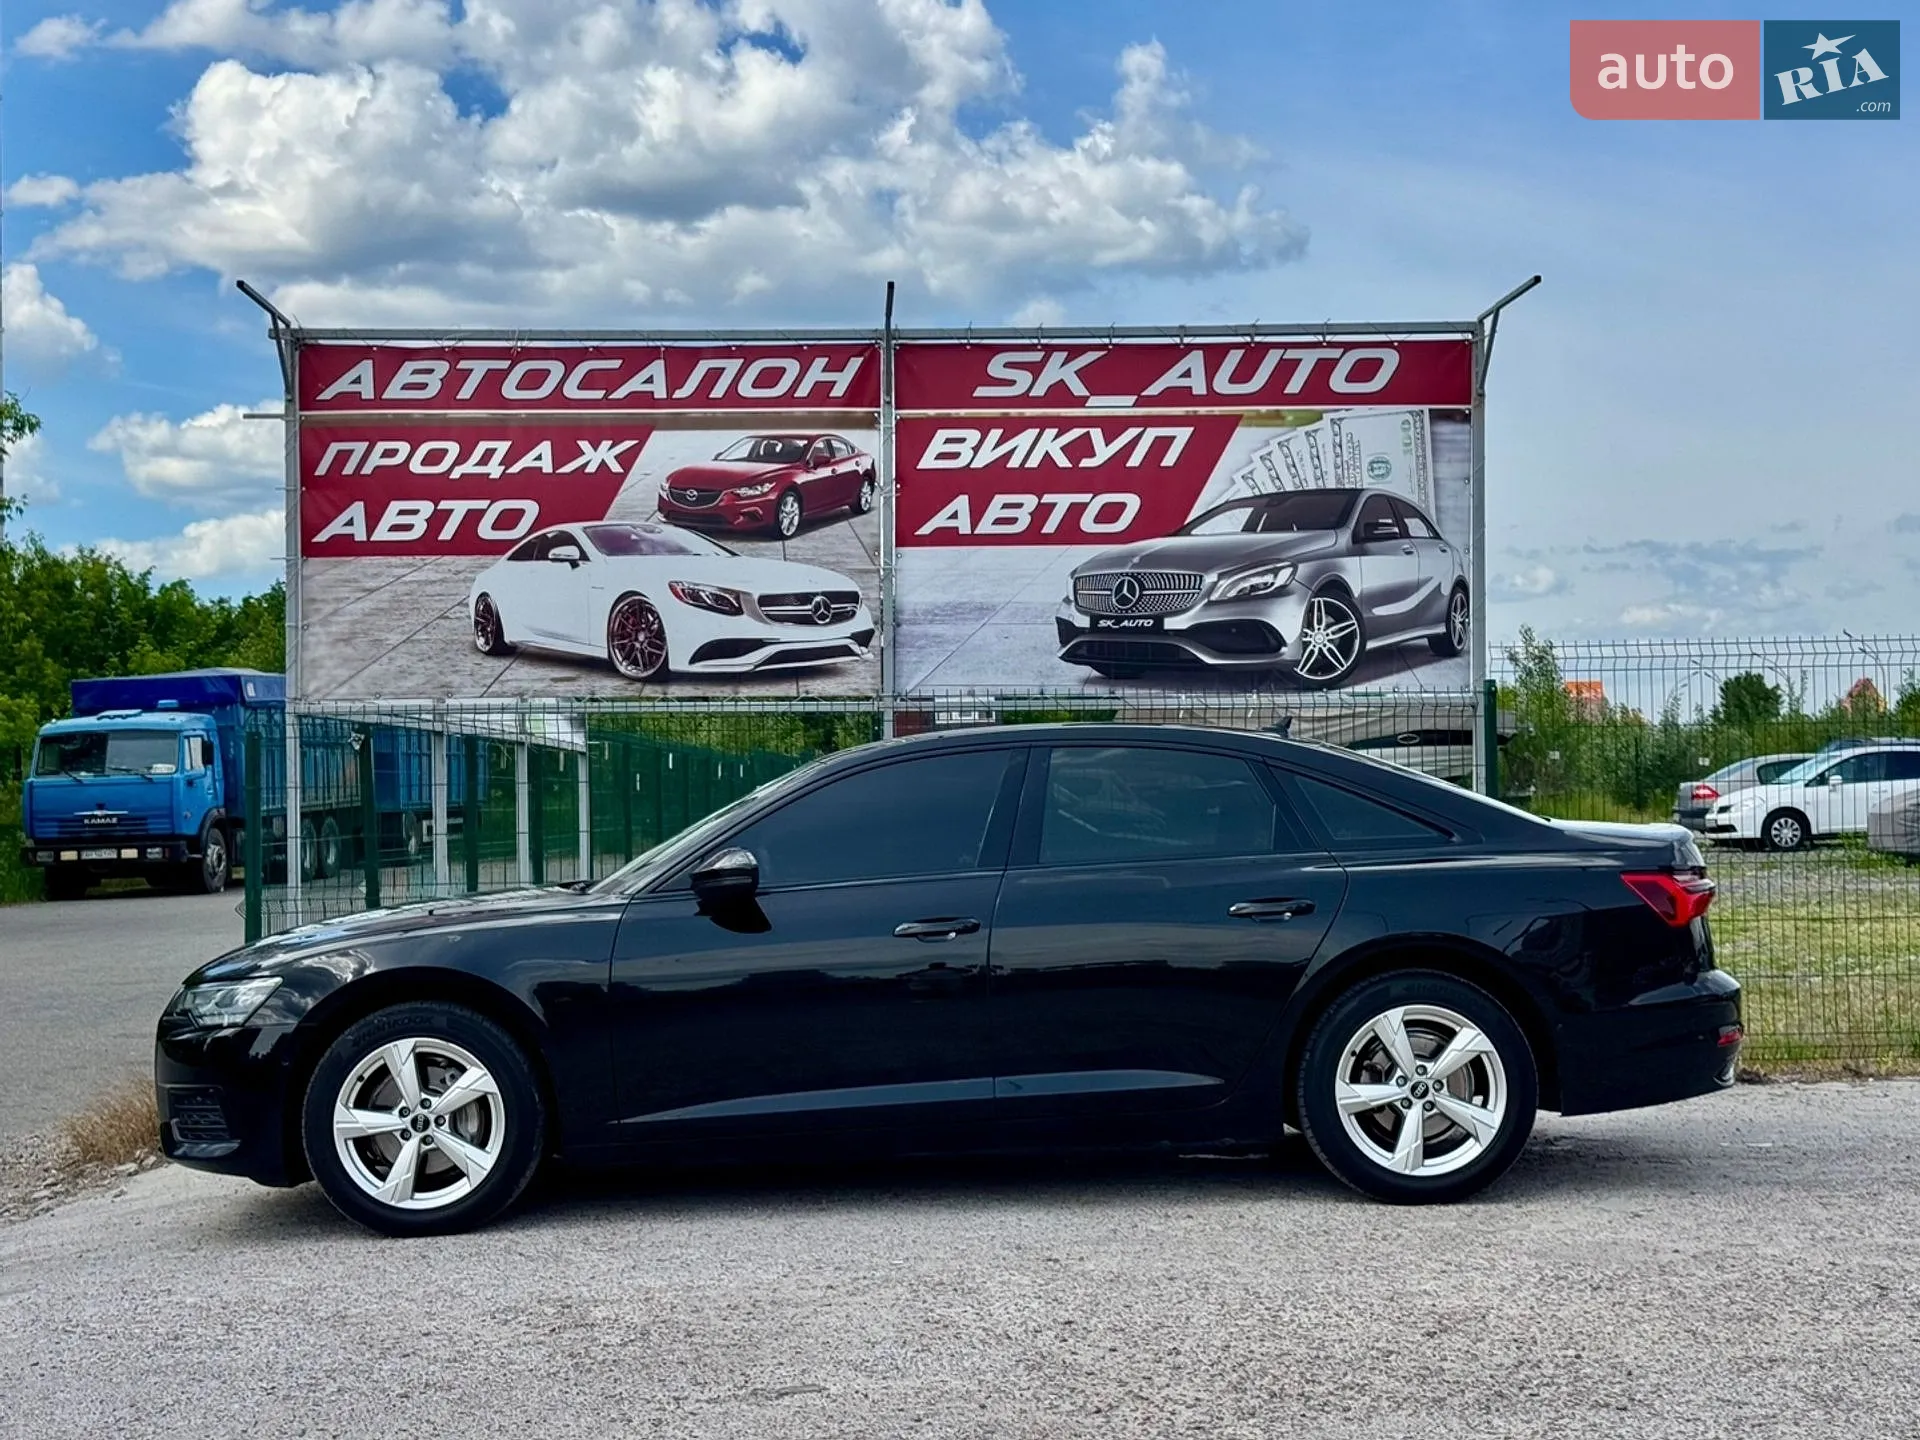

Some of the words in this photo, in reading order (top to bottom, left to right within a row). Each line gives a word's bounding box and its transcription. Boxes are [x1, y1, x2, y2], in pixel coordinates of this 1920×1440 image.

[316, 356, 865, 402] АВТОСАЛОН
[972, 346, 1401, 408] SK_AUTO
[313, 438, 640, 479] ПРОДАЖ
[916, 425, 1195, 470] ВИКУП
[312, 498, 540, 544] АВТО
[913, 491, 1141, 536] АВТО
[1097, 618, 1155, 629] SK_AUTO
